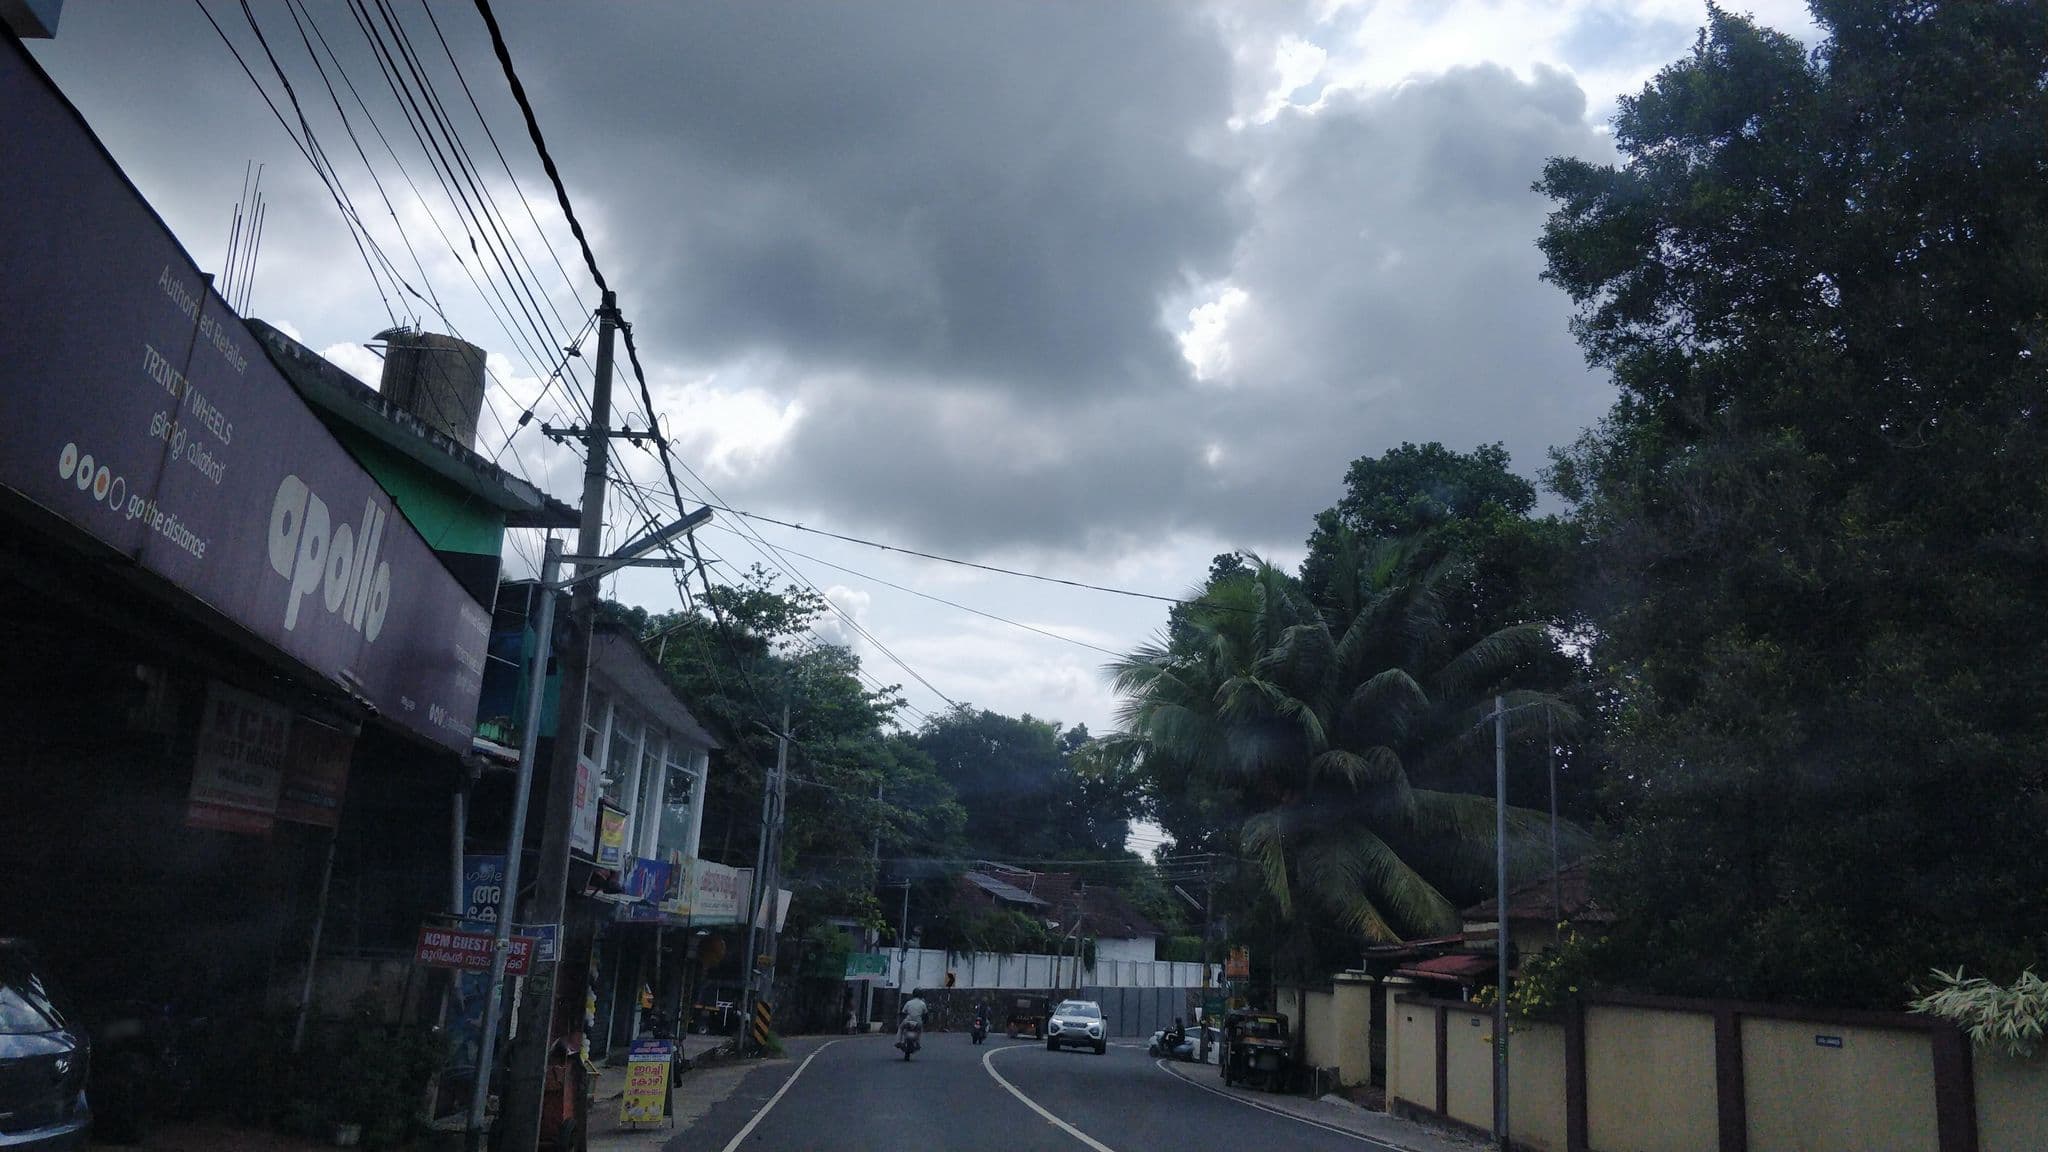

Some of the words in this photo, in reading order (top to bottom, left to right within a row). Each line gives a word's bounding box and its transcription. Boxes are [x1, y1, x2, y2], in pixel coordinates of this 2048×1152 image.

[158, 264, 214, 339] Authoried
[213, 323, 248, 376] Retailer
[143, 343, 193, 407] TRINITY
[191, 390, 233, 446] WHEELS
[126, 494, 145, 520] go
[144, 499, 164, 531] the
[163, 513, 206, 560] distance
[268, 474, 391, 643] apollo
[424, 931, 451, 949] KCM
[452, 935, 489, 952] GUEST
